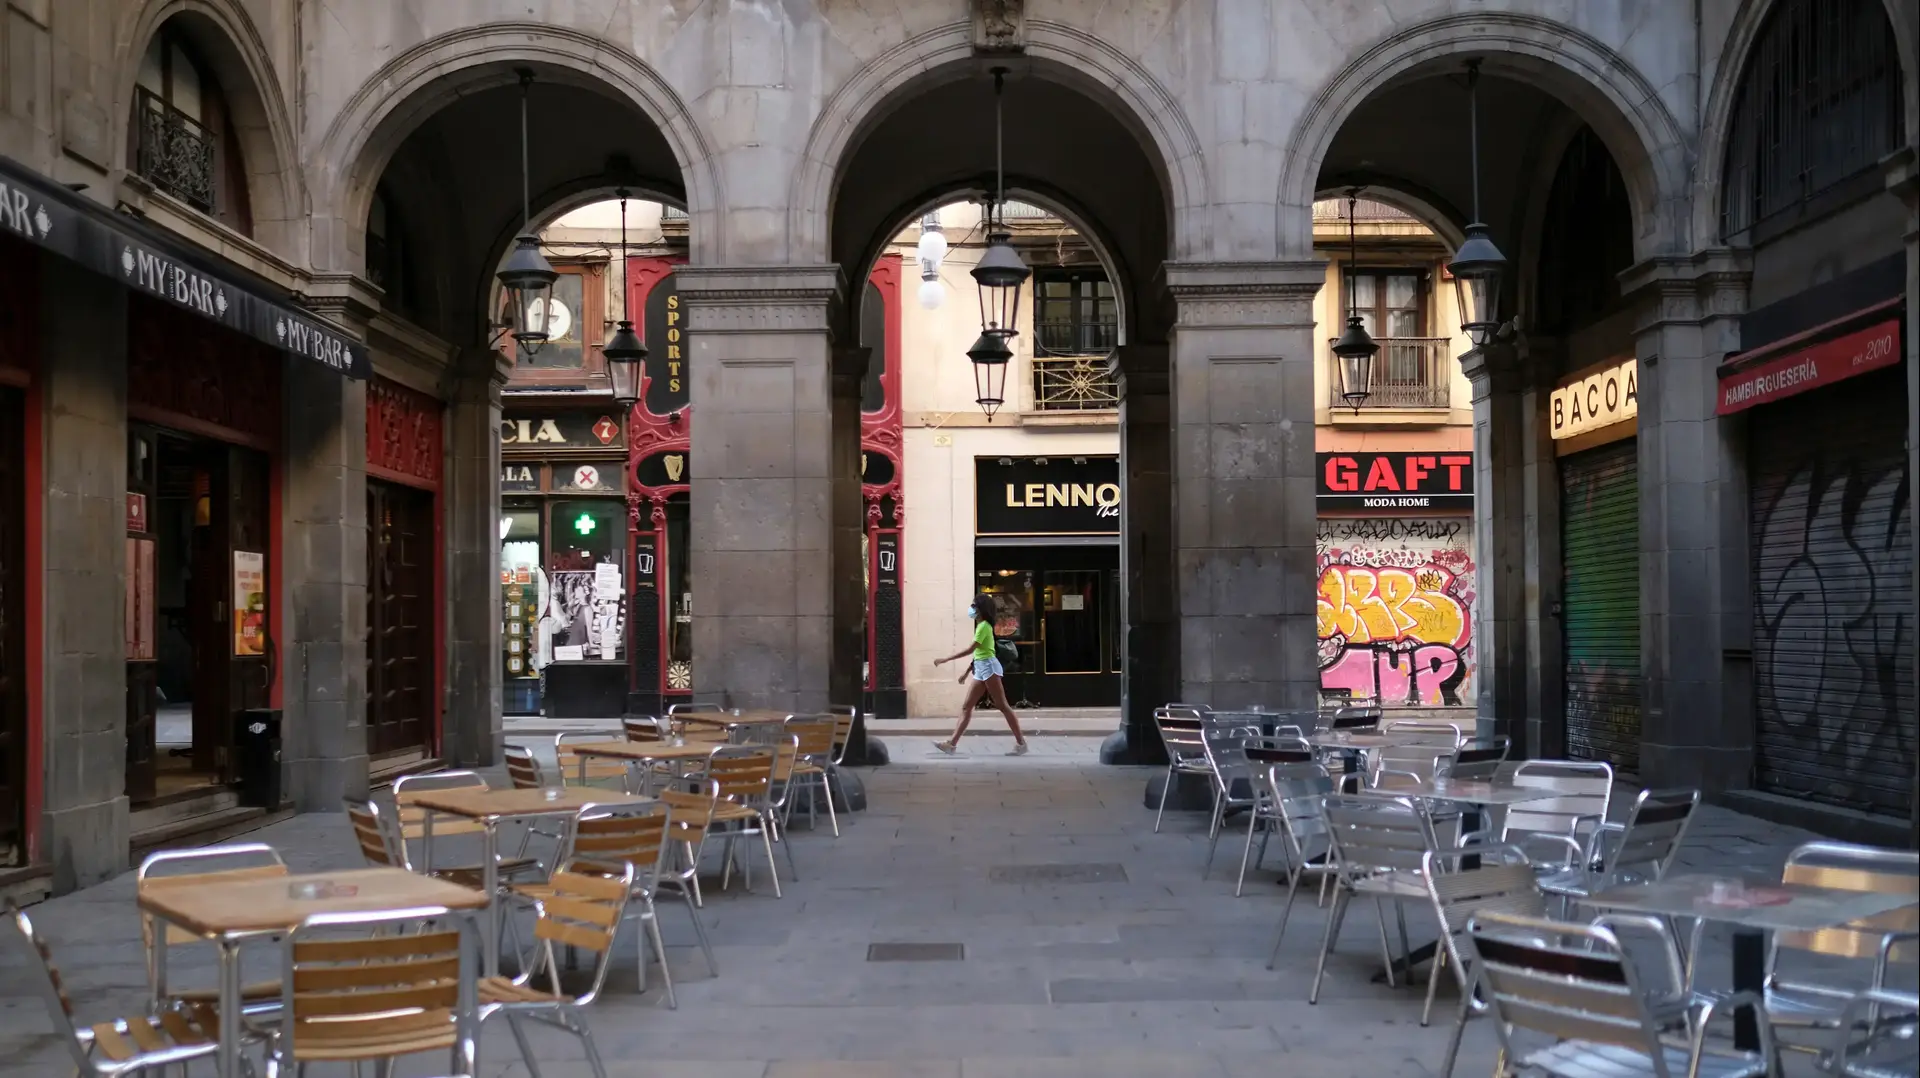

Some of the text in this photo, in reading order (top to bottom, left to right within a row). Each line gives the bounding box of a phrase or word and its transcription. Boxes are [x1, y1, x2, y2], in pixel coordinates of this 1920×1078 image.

[138, 248, 168, 294] MY
[174, 266, 215, 316] BAR
[287, 317, 310, 355] MY
[313, 329, 342, 369] BAR
[667, 295, 681, 393] SPORTS
[1724, 357, 1818, 406] HAMBURGUESERÍA
[1865, 335, 1892, 361] 2010
[1554, 370, 1638, 430] BACOA
[600, 422, 612, 439] 7
[1325, 456, 1471, 492] GAFT
[1364, 498, 1430, 507] MODA HOME
